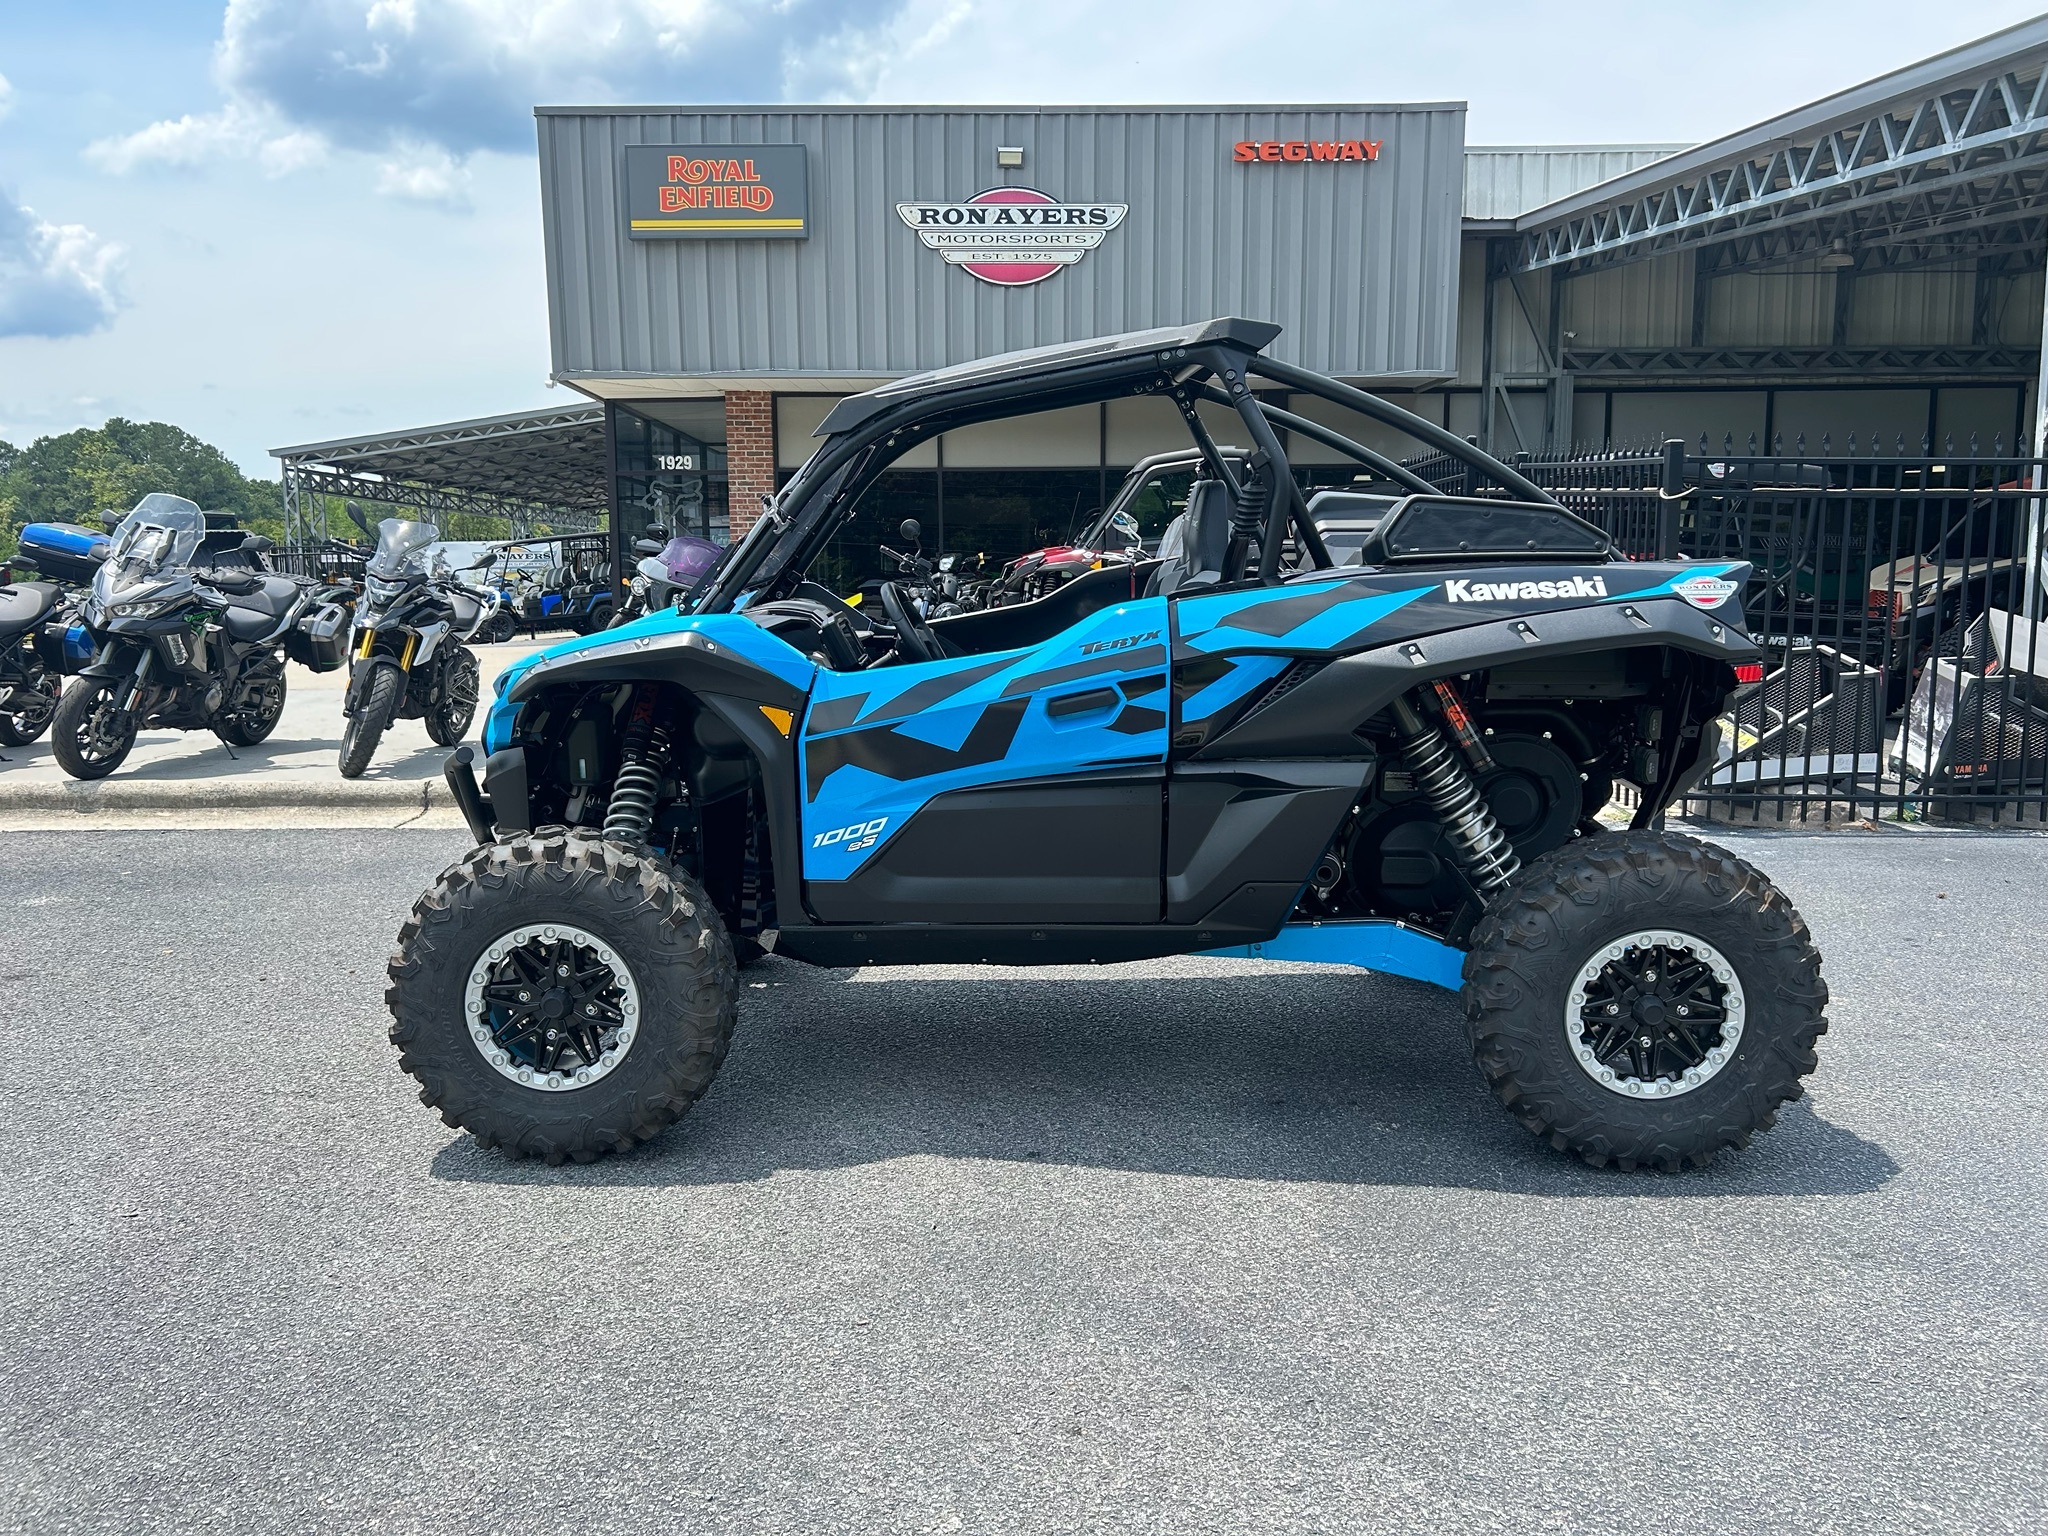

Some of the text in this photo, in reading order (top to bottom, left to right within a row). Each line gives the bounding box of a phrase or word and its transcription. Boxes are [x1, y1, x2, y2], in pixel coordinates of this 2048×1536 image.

[1233, 140, 1384, 162] SEGWAY
[667, 155, 761, 185] ROYAL
[658, 185, 774, 213] ENFIELD
[917, 207, 1109, 225] RON AYERS
[937, 234, 1087, 244] MOTORSPORTS
[1015, 252, 1052, 260] 1975
[658, 455, 693, 470] 1929
[509, 552, 551, 560] AYERS
[1445, 575, 1609, 603] Kawasaki
[1078, 629, 1164, 656] TERYX
[1954, 763, 1988, 774] YAMHA
[812, 816, 889, 849] 1000
